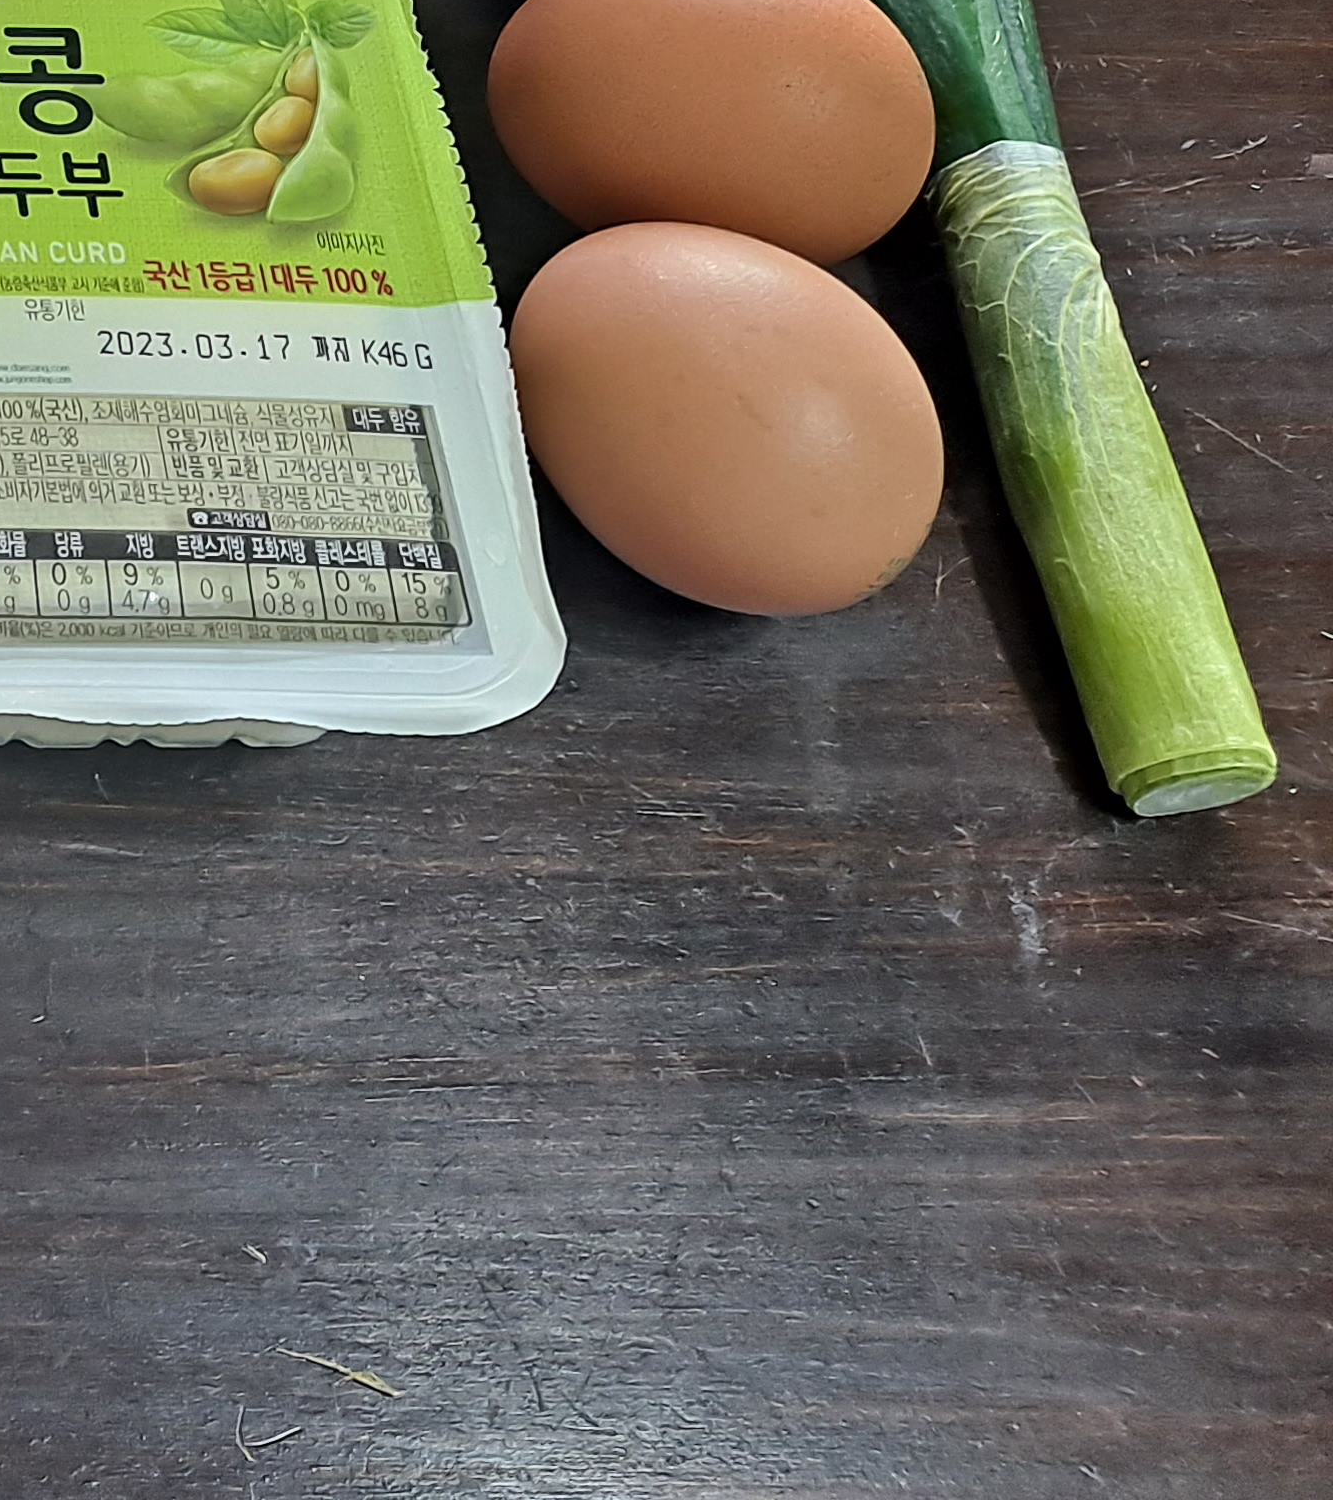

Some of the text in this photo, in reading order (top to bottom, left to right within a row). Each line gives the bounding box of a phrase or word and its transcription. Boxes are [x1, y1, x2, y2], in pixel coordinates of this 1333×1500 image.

[49, 240, 127, 266] CURD
[316, 231, 386, 256] 이미지사진
[142, 260, 394, 297] 국산 1등급 대두 100 %
[23, 299, 86, 323] 유통기한
[96, 330, 292, 361] 2023.03.17
[256, 404, 336, 428] 식물성유지
[352, 408, 421, 433] 대두 함유
[30, 426, 79, 447] 48-38
[167, 428, 231, 453] 유통기한
[239, 431, 270, 455] 전면
[172, 455, 204, 479] 반품
[226, 456, 260, 481] 교환
[275, 459, 354, 484] 고객상담실
[209, 511, 268, 531] 고객상담실
[55, 531, 84, 558] 당류
[126, 533, 154, 560] 지방
[176, 534, 246, 562] 트랜스지방
[252, 538, 306, 565] 포화지방
[315, 540, 385, 567] 콜레스테롤
[398, 543, 442, 569] 단백질
[402, 572, 427, 595] 15
[263, 592, 296, 616] 0.8
[356, 600, 386, 620] mg
